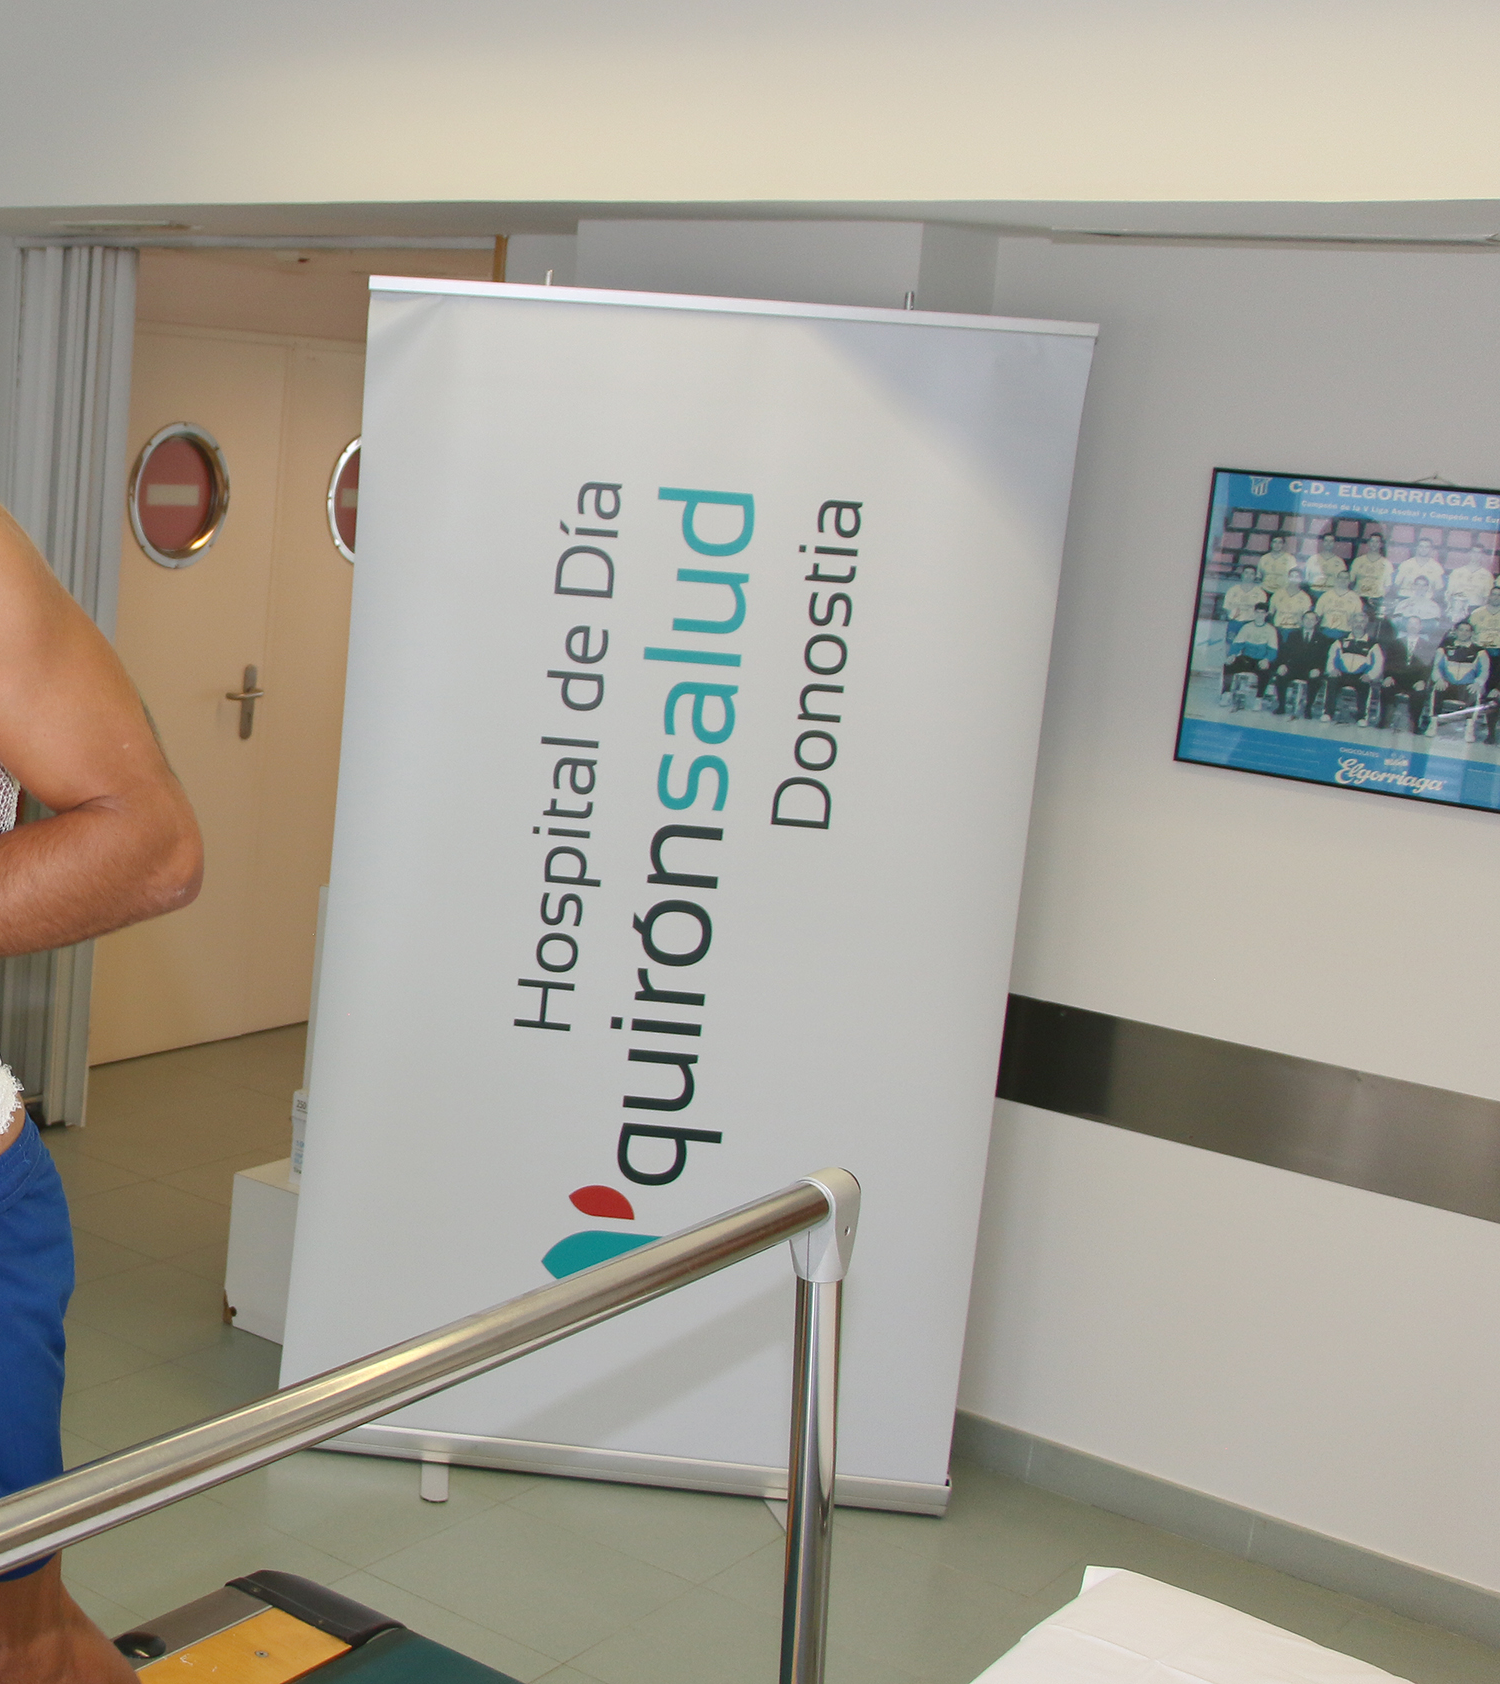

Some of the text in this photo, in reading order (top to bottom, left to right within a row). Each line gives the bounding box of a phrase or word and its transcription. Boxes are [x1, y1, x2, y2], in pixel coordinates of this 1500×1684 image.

[1289, 480, 1330, 495] C.D.
[1338, 484, 1477, 508] ELGORRIAGA
[513, 481, 623, 1033] Hospital de Día
[771, 498, 864, 831] Donostia
[1335, 756, 1445, 794] Elgorriaga
[611, 487, 755, 1186] quirónsalud
